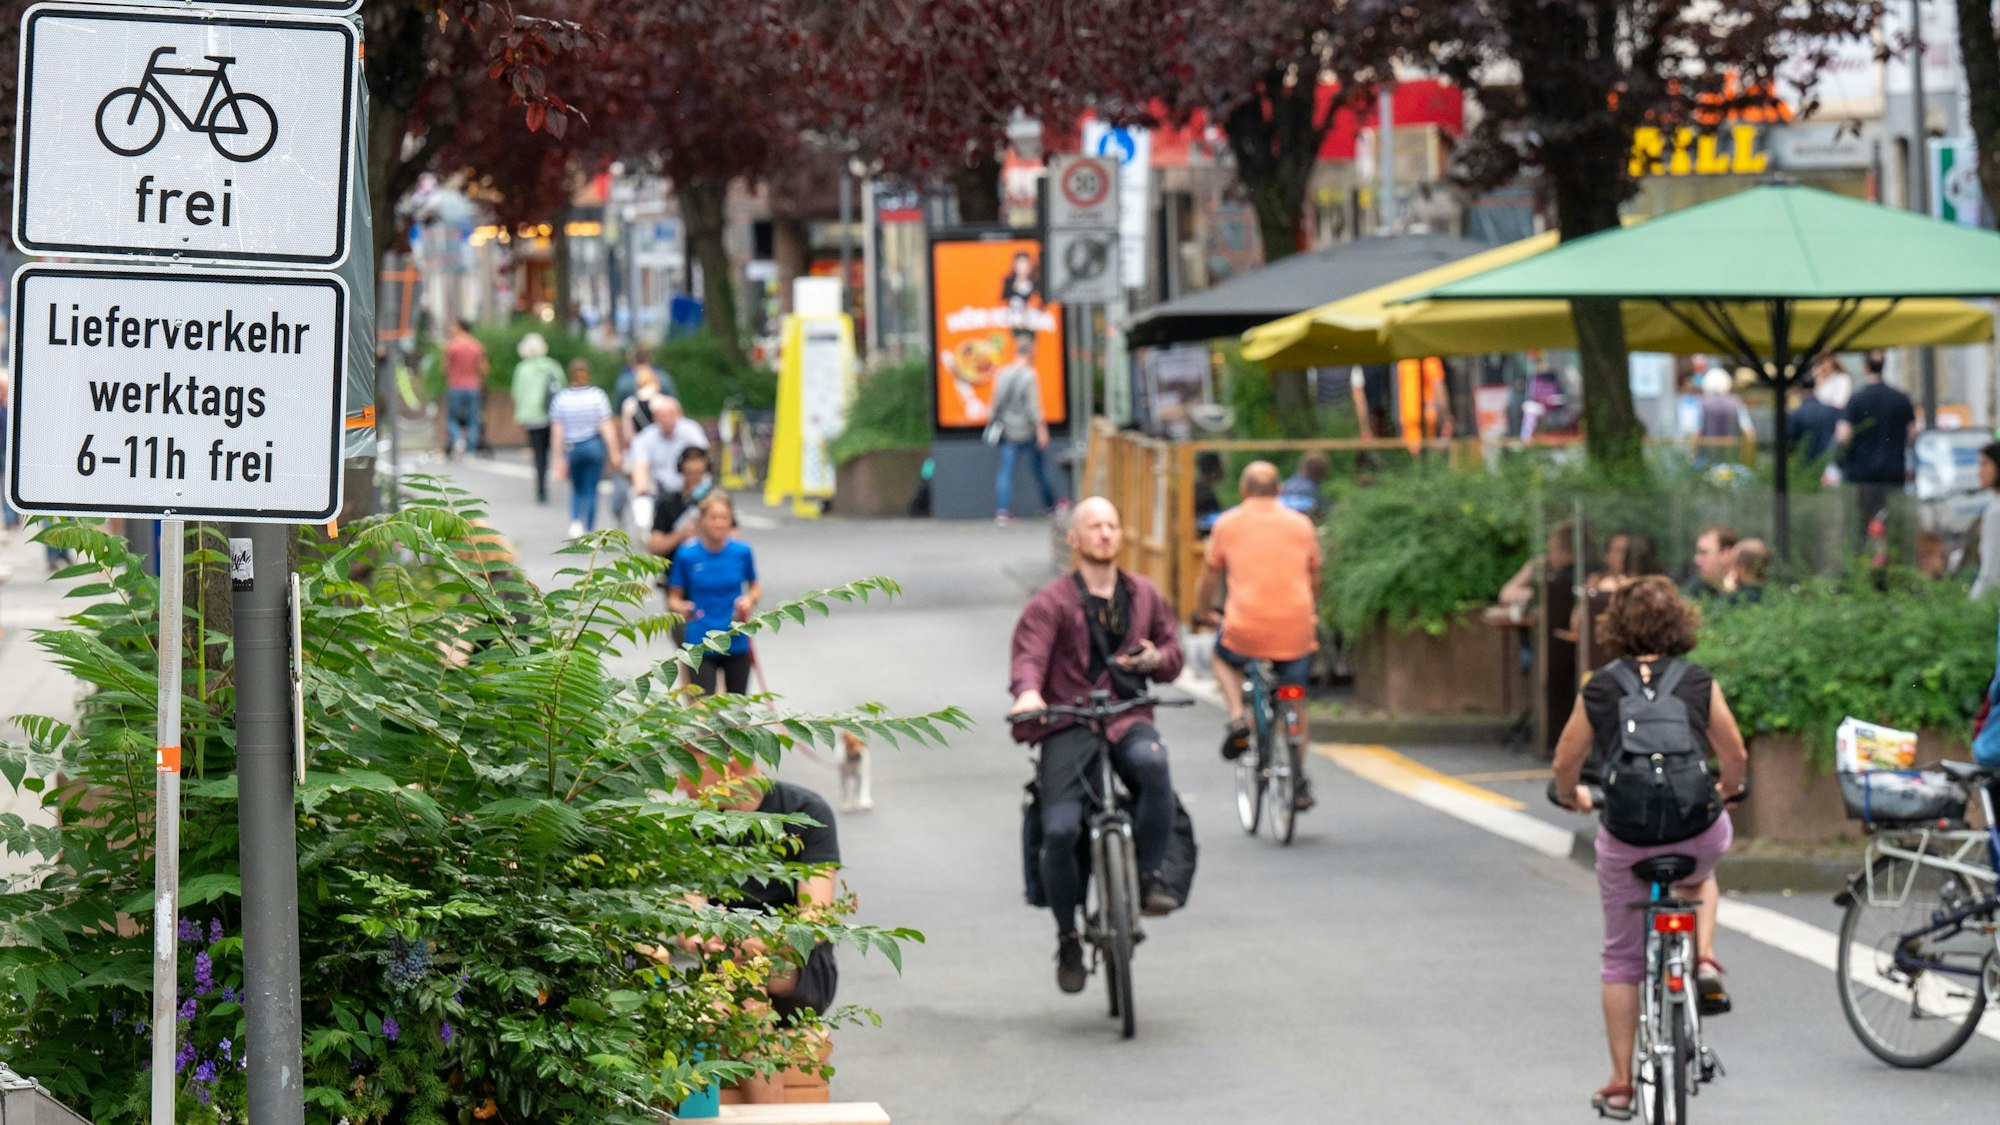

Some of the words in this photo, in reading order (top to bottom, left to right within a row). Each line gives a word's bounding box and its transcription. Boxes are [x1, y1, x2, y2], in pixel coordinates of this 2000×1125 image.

[135, 175, 232, 227] frei
[48, 302, 310, 355] Lieferverkehr
[88, 372, 266, 429] werktags
[77, 434, 186, 480] 6-11h
[208, 438, 273, 483] frei
